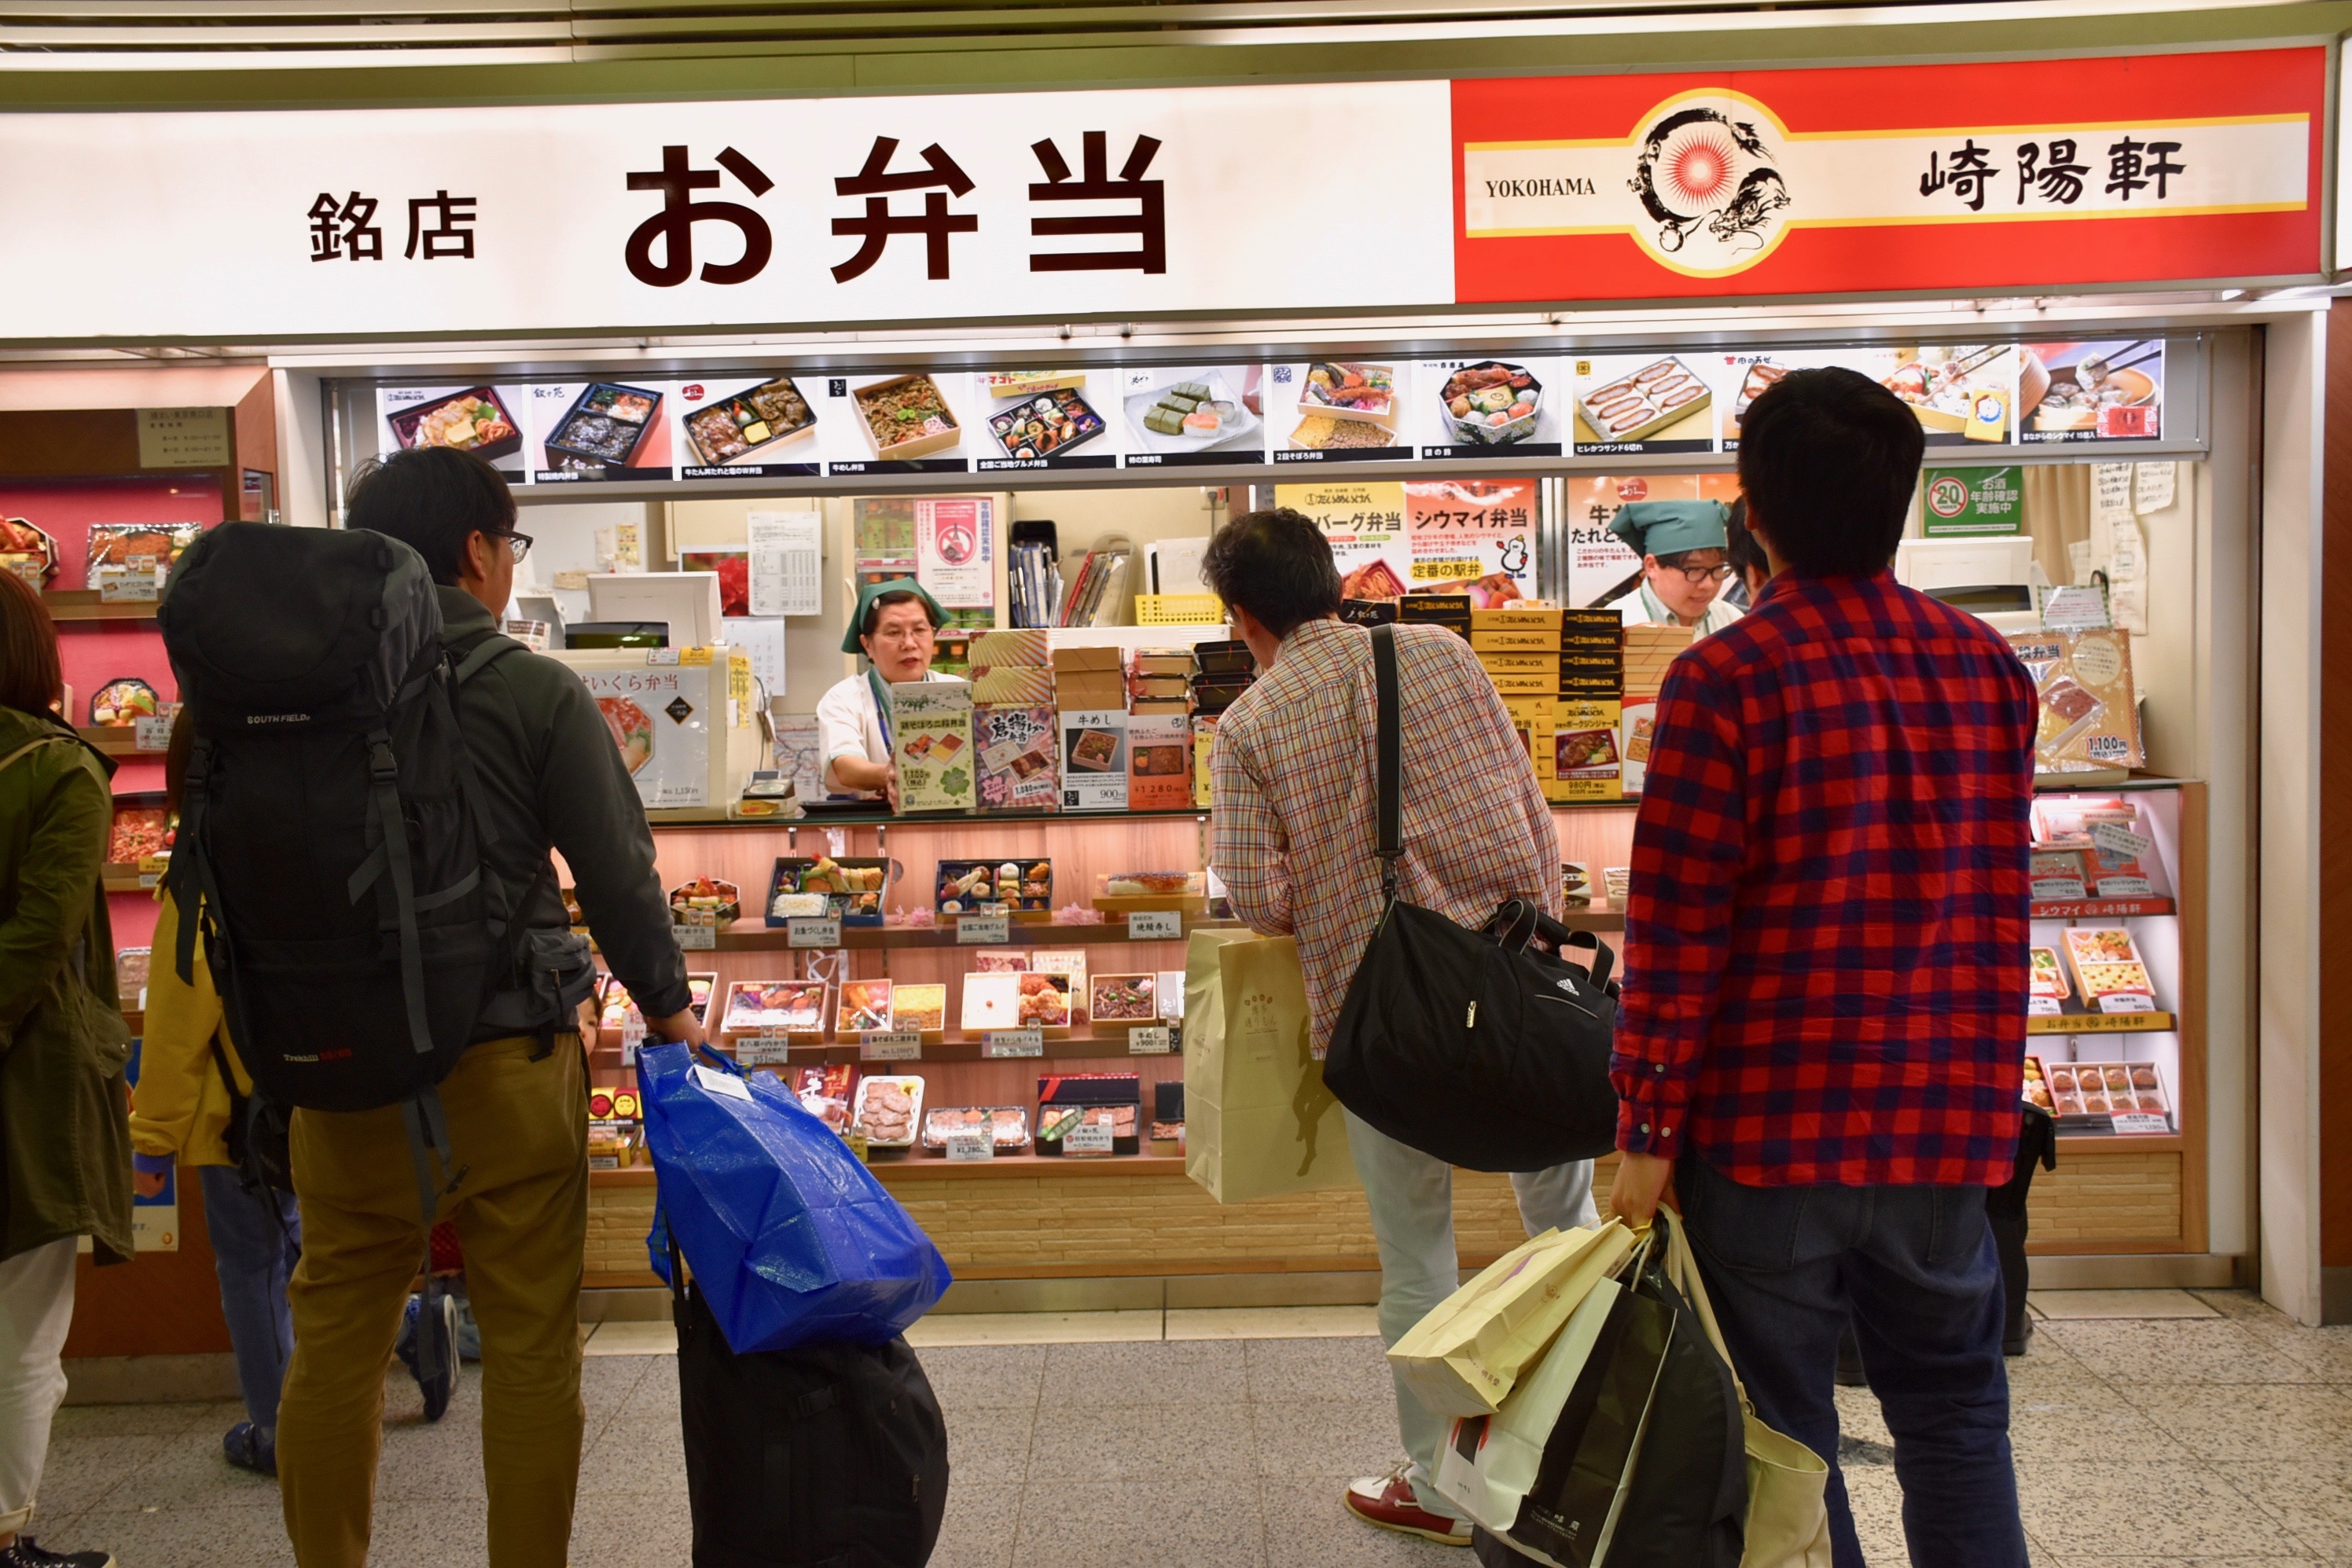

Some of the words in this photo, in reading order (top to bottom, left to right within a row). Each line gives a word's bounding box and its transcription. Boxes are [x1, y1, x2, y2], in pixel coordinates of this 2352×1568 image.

[1919, 135, 2187, 211] 崎陽軒
[1484, 177, 1597, 197] YOKOHAMA
[624, 130, 1167, 287] お弁当
[307, 190, 477, 262] 銘店
[1576, 443, 1644, 454] ヒレかつサンド6切れ
[832, 462, 865, 472] 牛めし弁当
[979, 458, 1049, 469] 全国ご当地グルメ弁当
[1982, 477, 2007, 490] お酒
[1936, 484, 1960, 505] 20
[1969, 489, 2019, 503] 年齢確認
[1975, 501, 2012, 515] 実施中
[1414, 507, 1527, 530] シウマイ弁当
[1412, 564, 1479, 578] 定番の駅弁
[247, 714, 280, 725] SOUTH
[280, 714, 307, 722] FIELD
[1078, 714, 1112, 726] 牛めし
[2039, 905, 2081, 916] シウマイ
